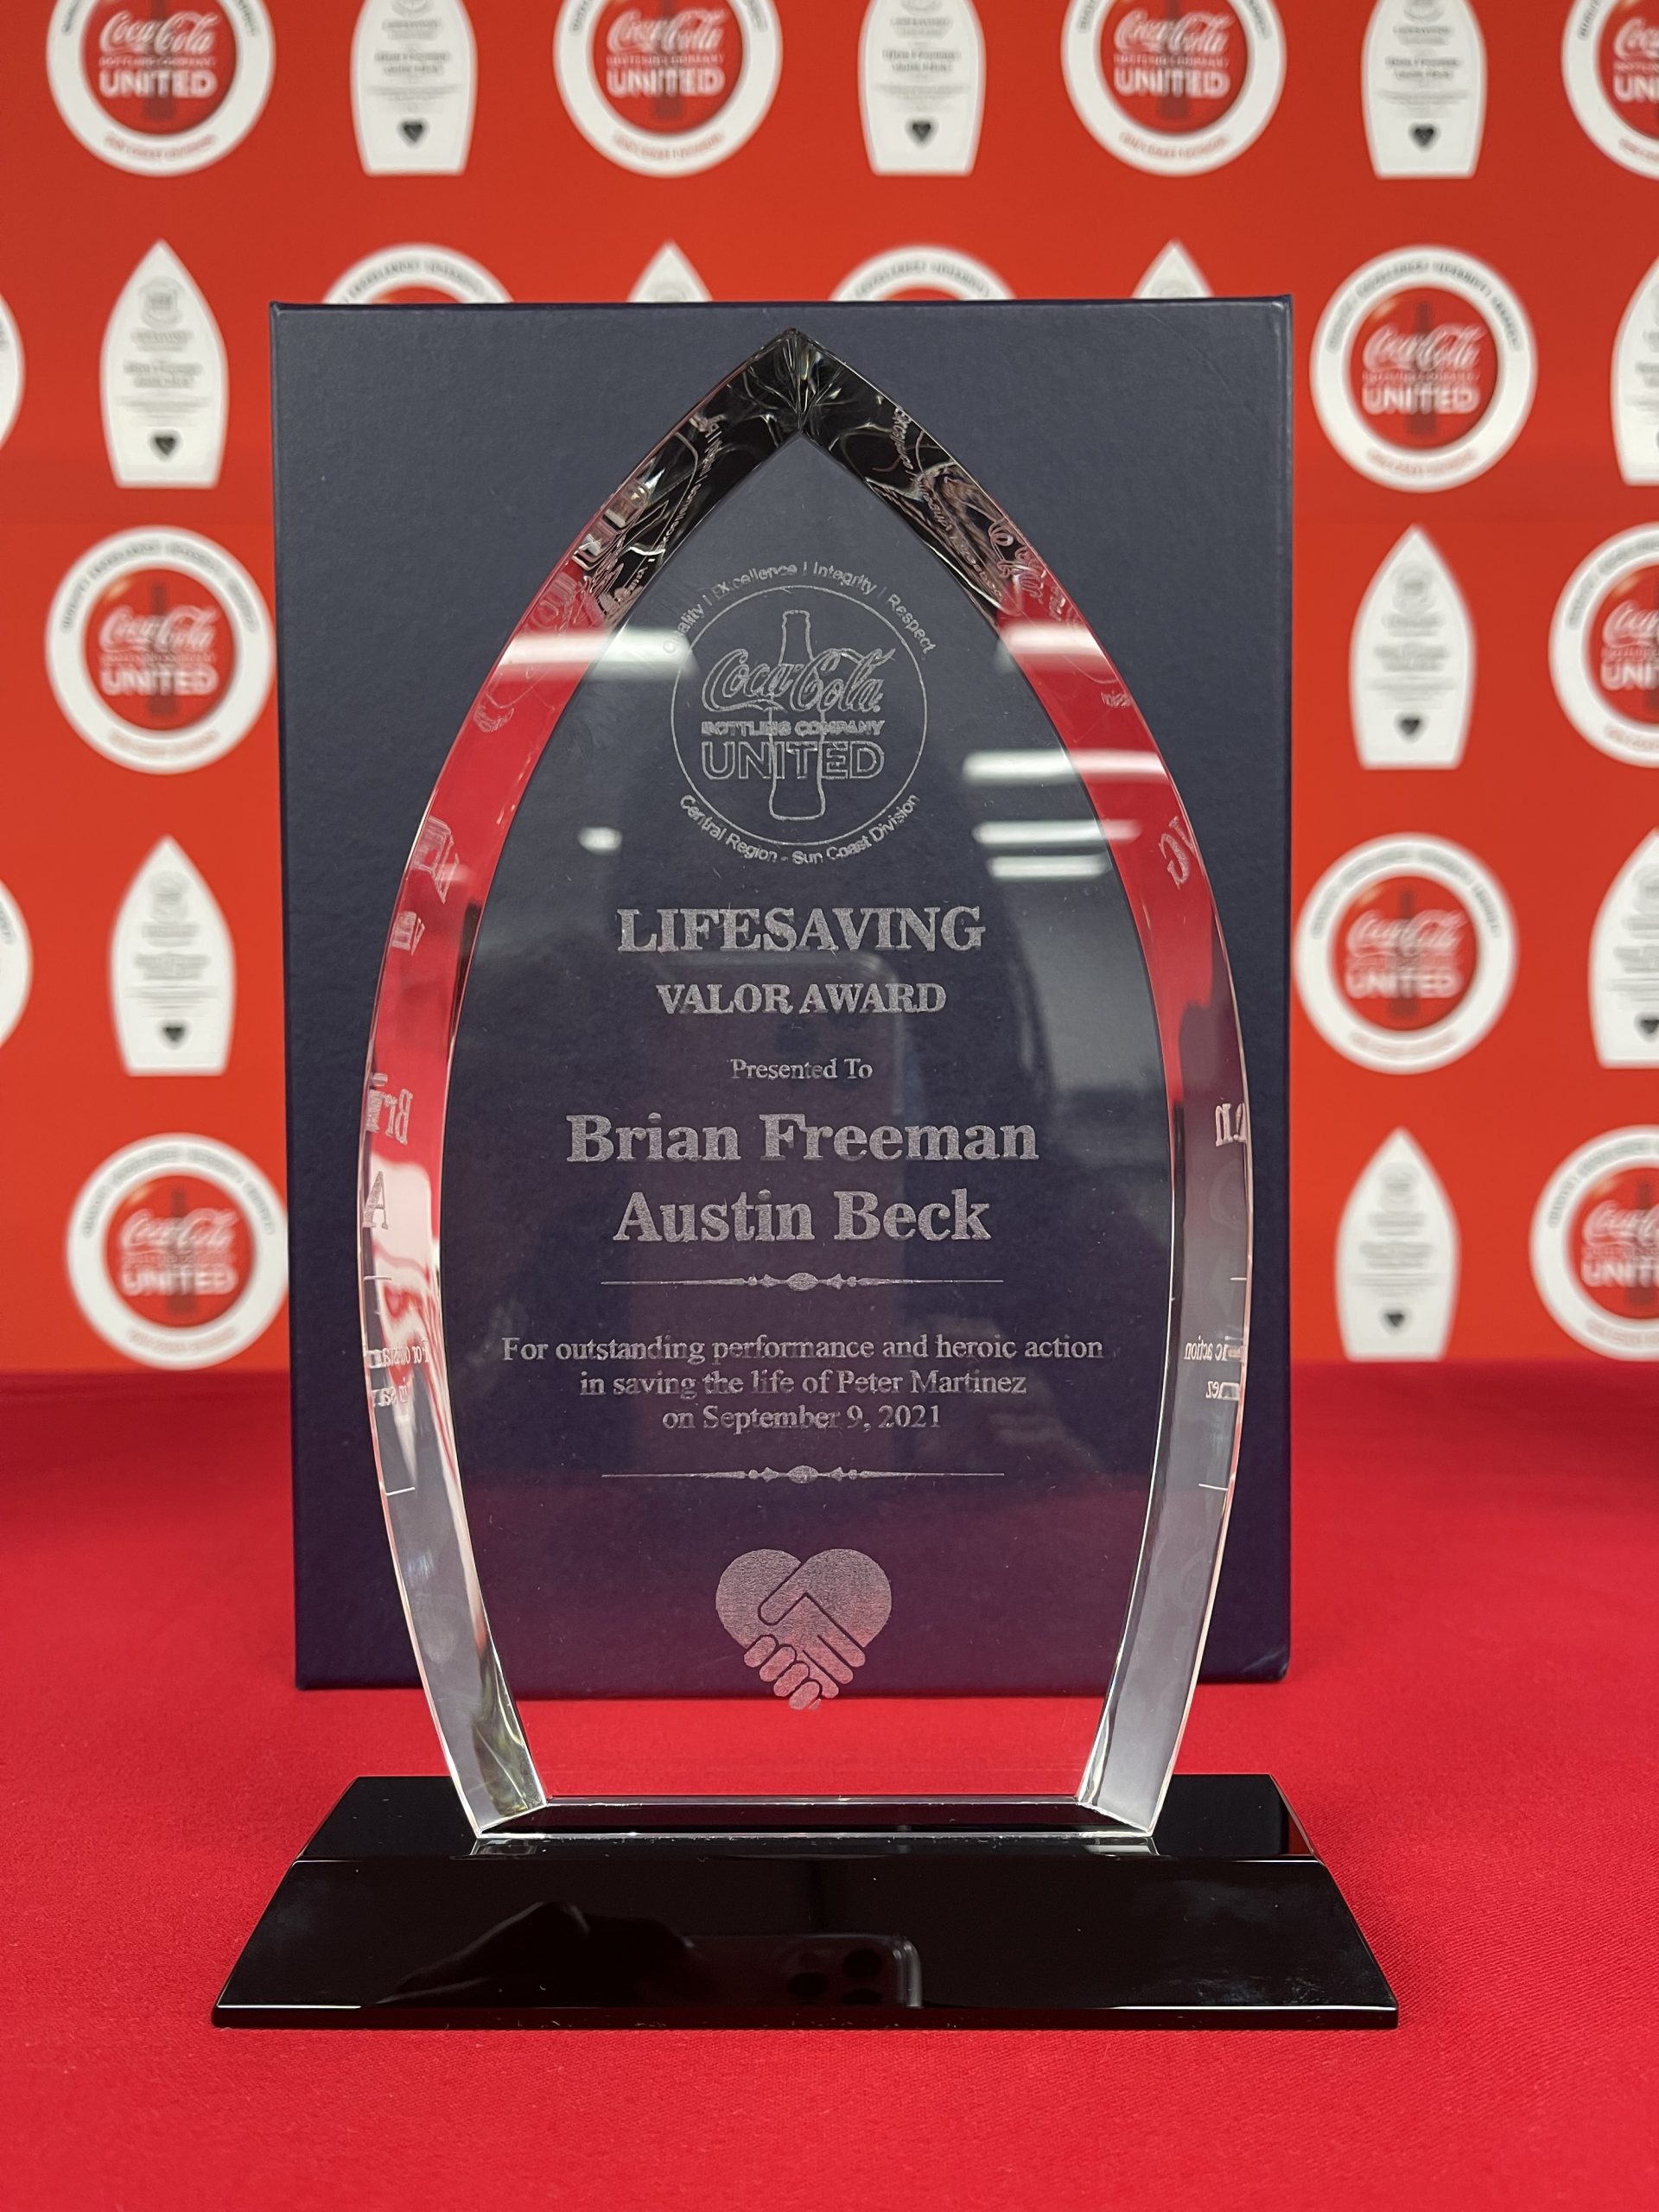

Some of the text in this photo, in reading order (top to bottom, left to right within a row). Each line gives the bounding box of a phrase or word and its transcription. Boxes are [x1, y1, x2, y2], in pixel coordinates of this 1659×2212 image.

[99, 68, 218, 99] UNITED
[606, 67, 726, 98] UNITED
[1113, 67, 1231, 99] UNITED
[1362, 384, 1481, 416] UNITED
[812, 561, 878, 596] Integrity
[887, 593, 937, 655] Respect
[99, 664, 219, 696] UNITED
[701, 720, 886, 736] BOTTLING COMPANY
[701, 741, 885, 779] UNITED
[680, 794, 728, 841] Central
[726, 832, 778, 863] Region
[791, 850, 823, 864] Sun
[826, 835, 873, 861] Coast
[868, 794, 920, 842] Division
[616, 906, 987, 952] LIFESAVING
[655, 982, 947, 1014] VALOR AWARD
[730, 1058, 874, 1080] Presented To
[566, 1112, 1039, 1163] Brian Freeman
[612, 1188, 992, 1243] Austin Beck
[501, 1333, 1105, 1365] For outstanding performance and heroic action
[580, 1369, 1027, 1400] in saving the life of Peter Martinez
[662, 1405, 941, 1435] on September 9, 2021
